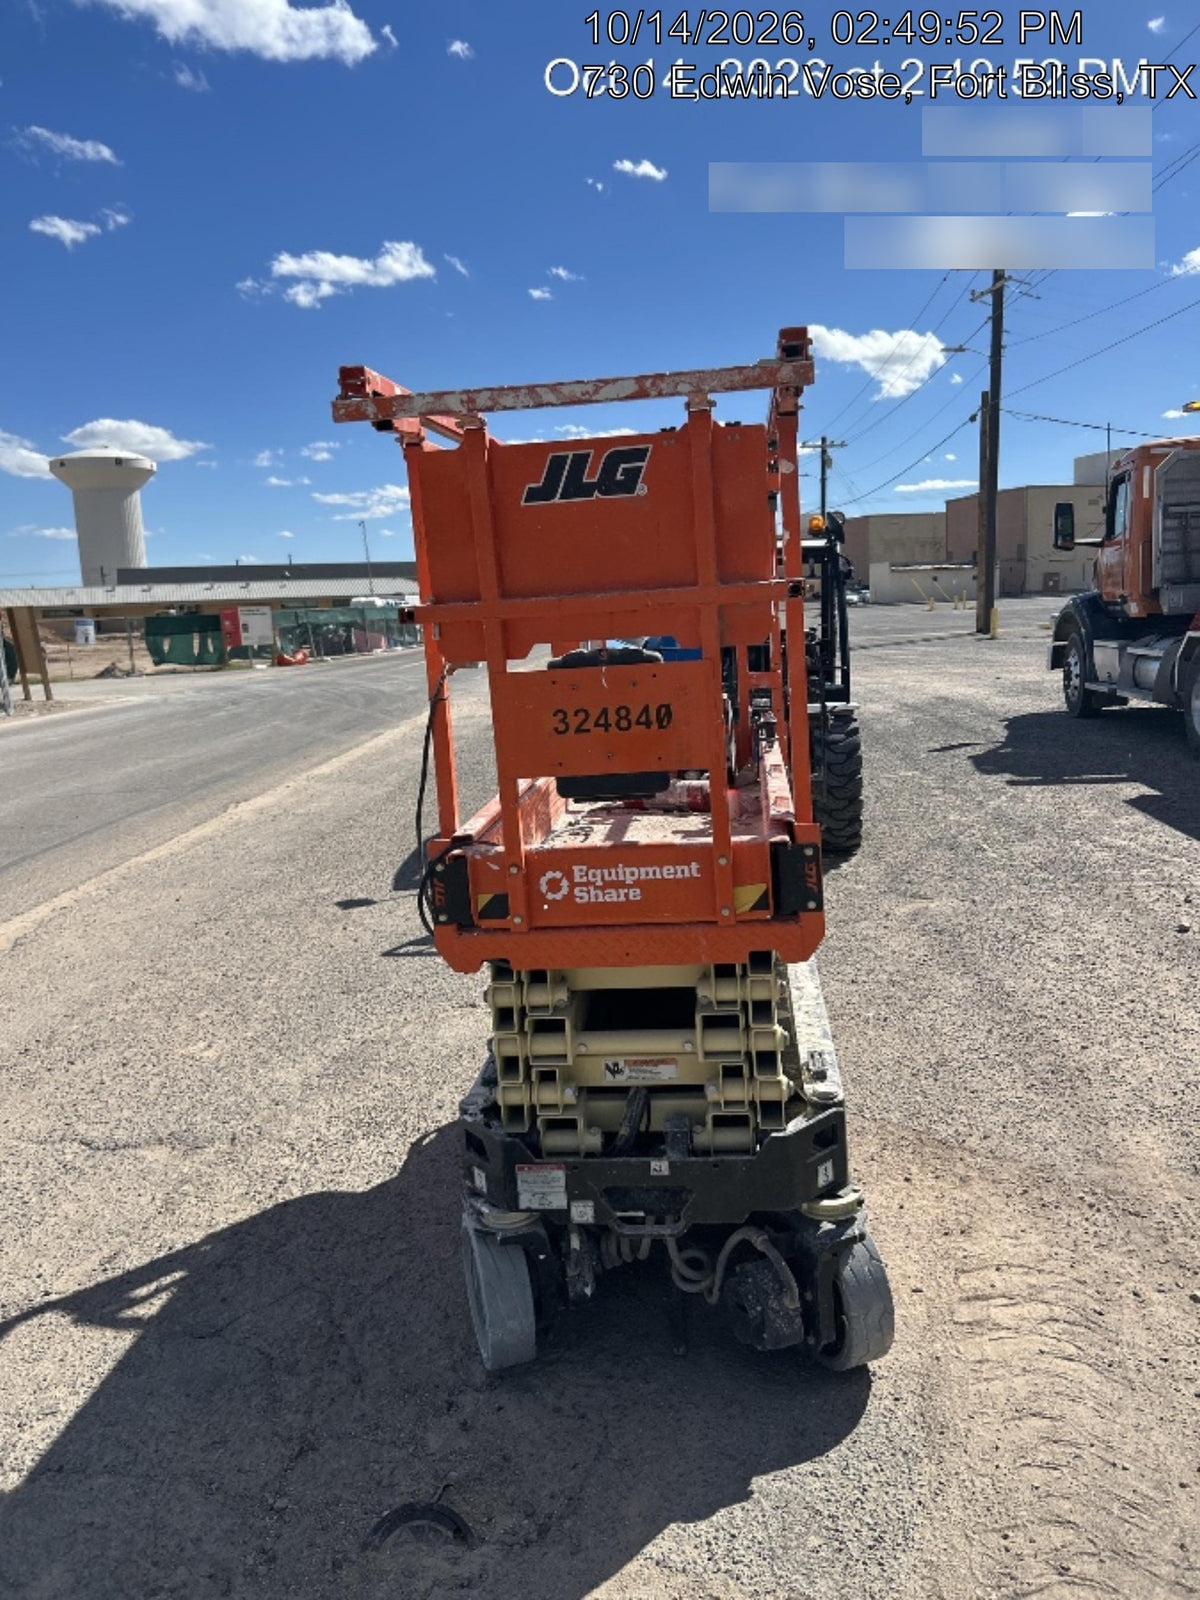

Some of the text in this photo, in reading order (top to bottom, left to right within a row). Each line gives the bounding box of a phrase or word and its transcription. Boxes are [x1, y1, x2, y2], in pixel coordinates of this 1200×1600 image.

[552, 703, 673, 735] 324840
[572, 861, 701, 886] Equipment
[573, 885, 642, 904] Share
